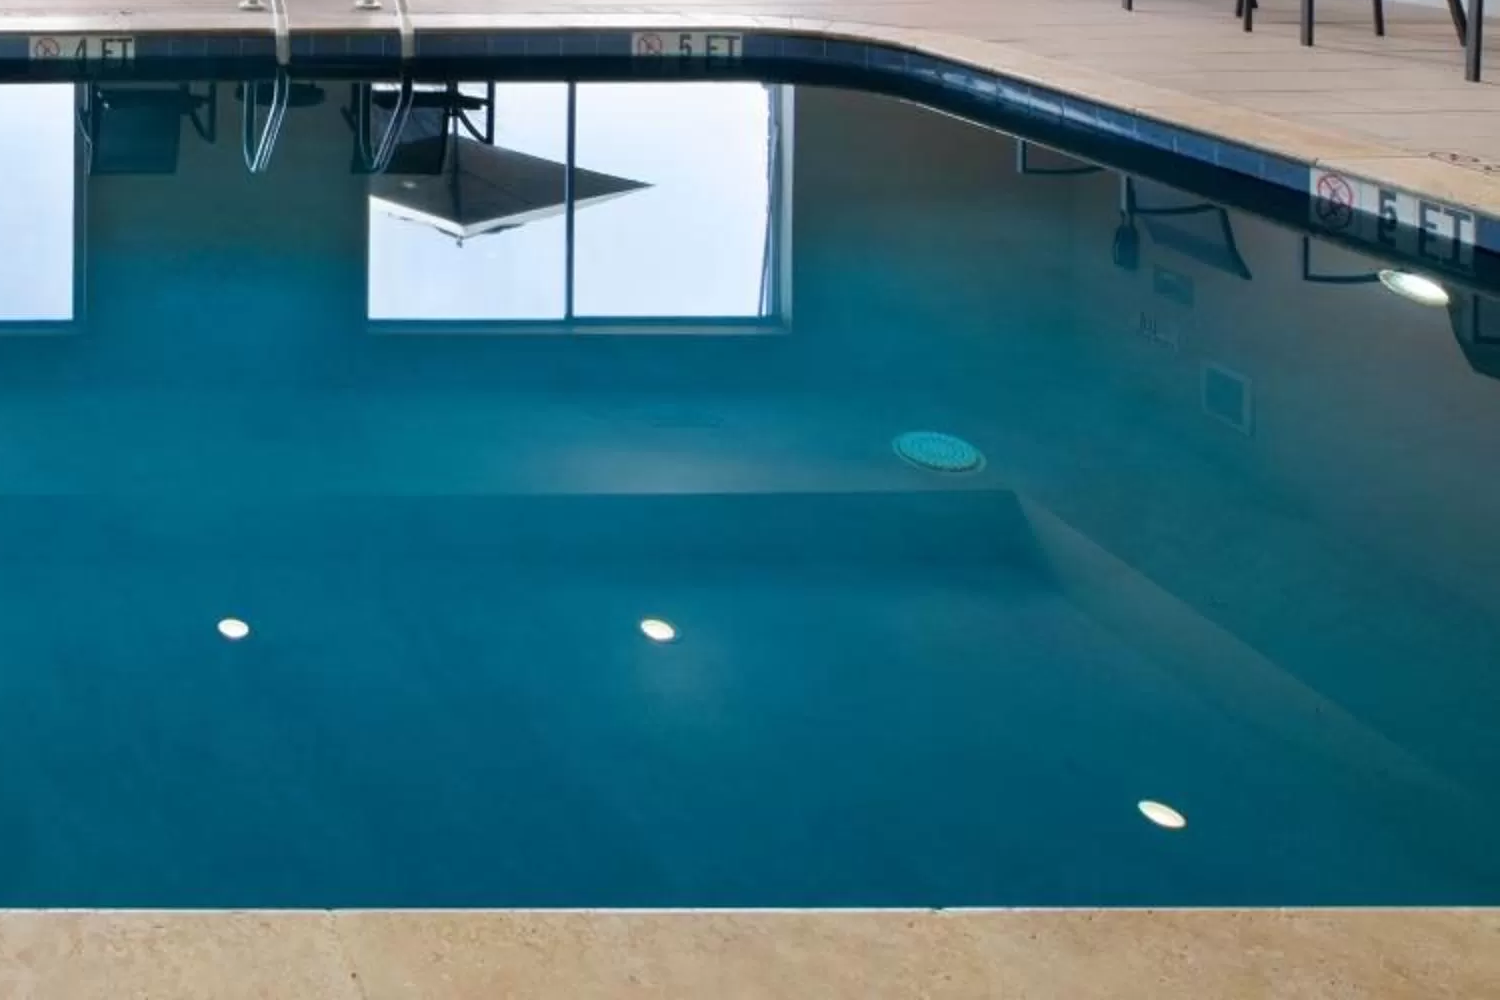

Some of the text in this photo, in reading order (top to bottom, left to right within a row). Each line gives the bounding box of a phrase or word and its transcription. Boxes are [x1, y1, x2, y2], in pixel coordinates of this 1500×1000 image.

[100, 37, 133, 59] FT
[678, 33, 741, 57] 5 FT
[1378, 188, 1473, 240] 5 FT
